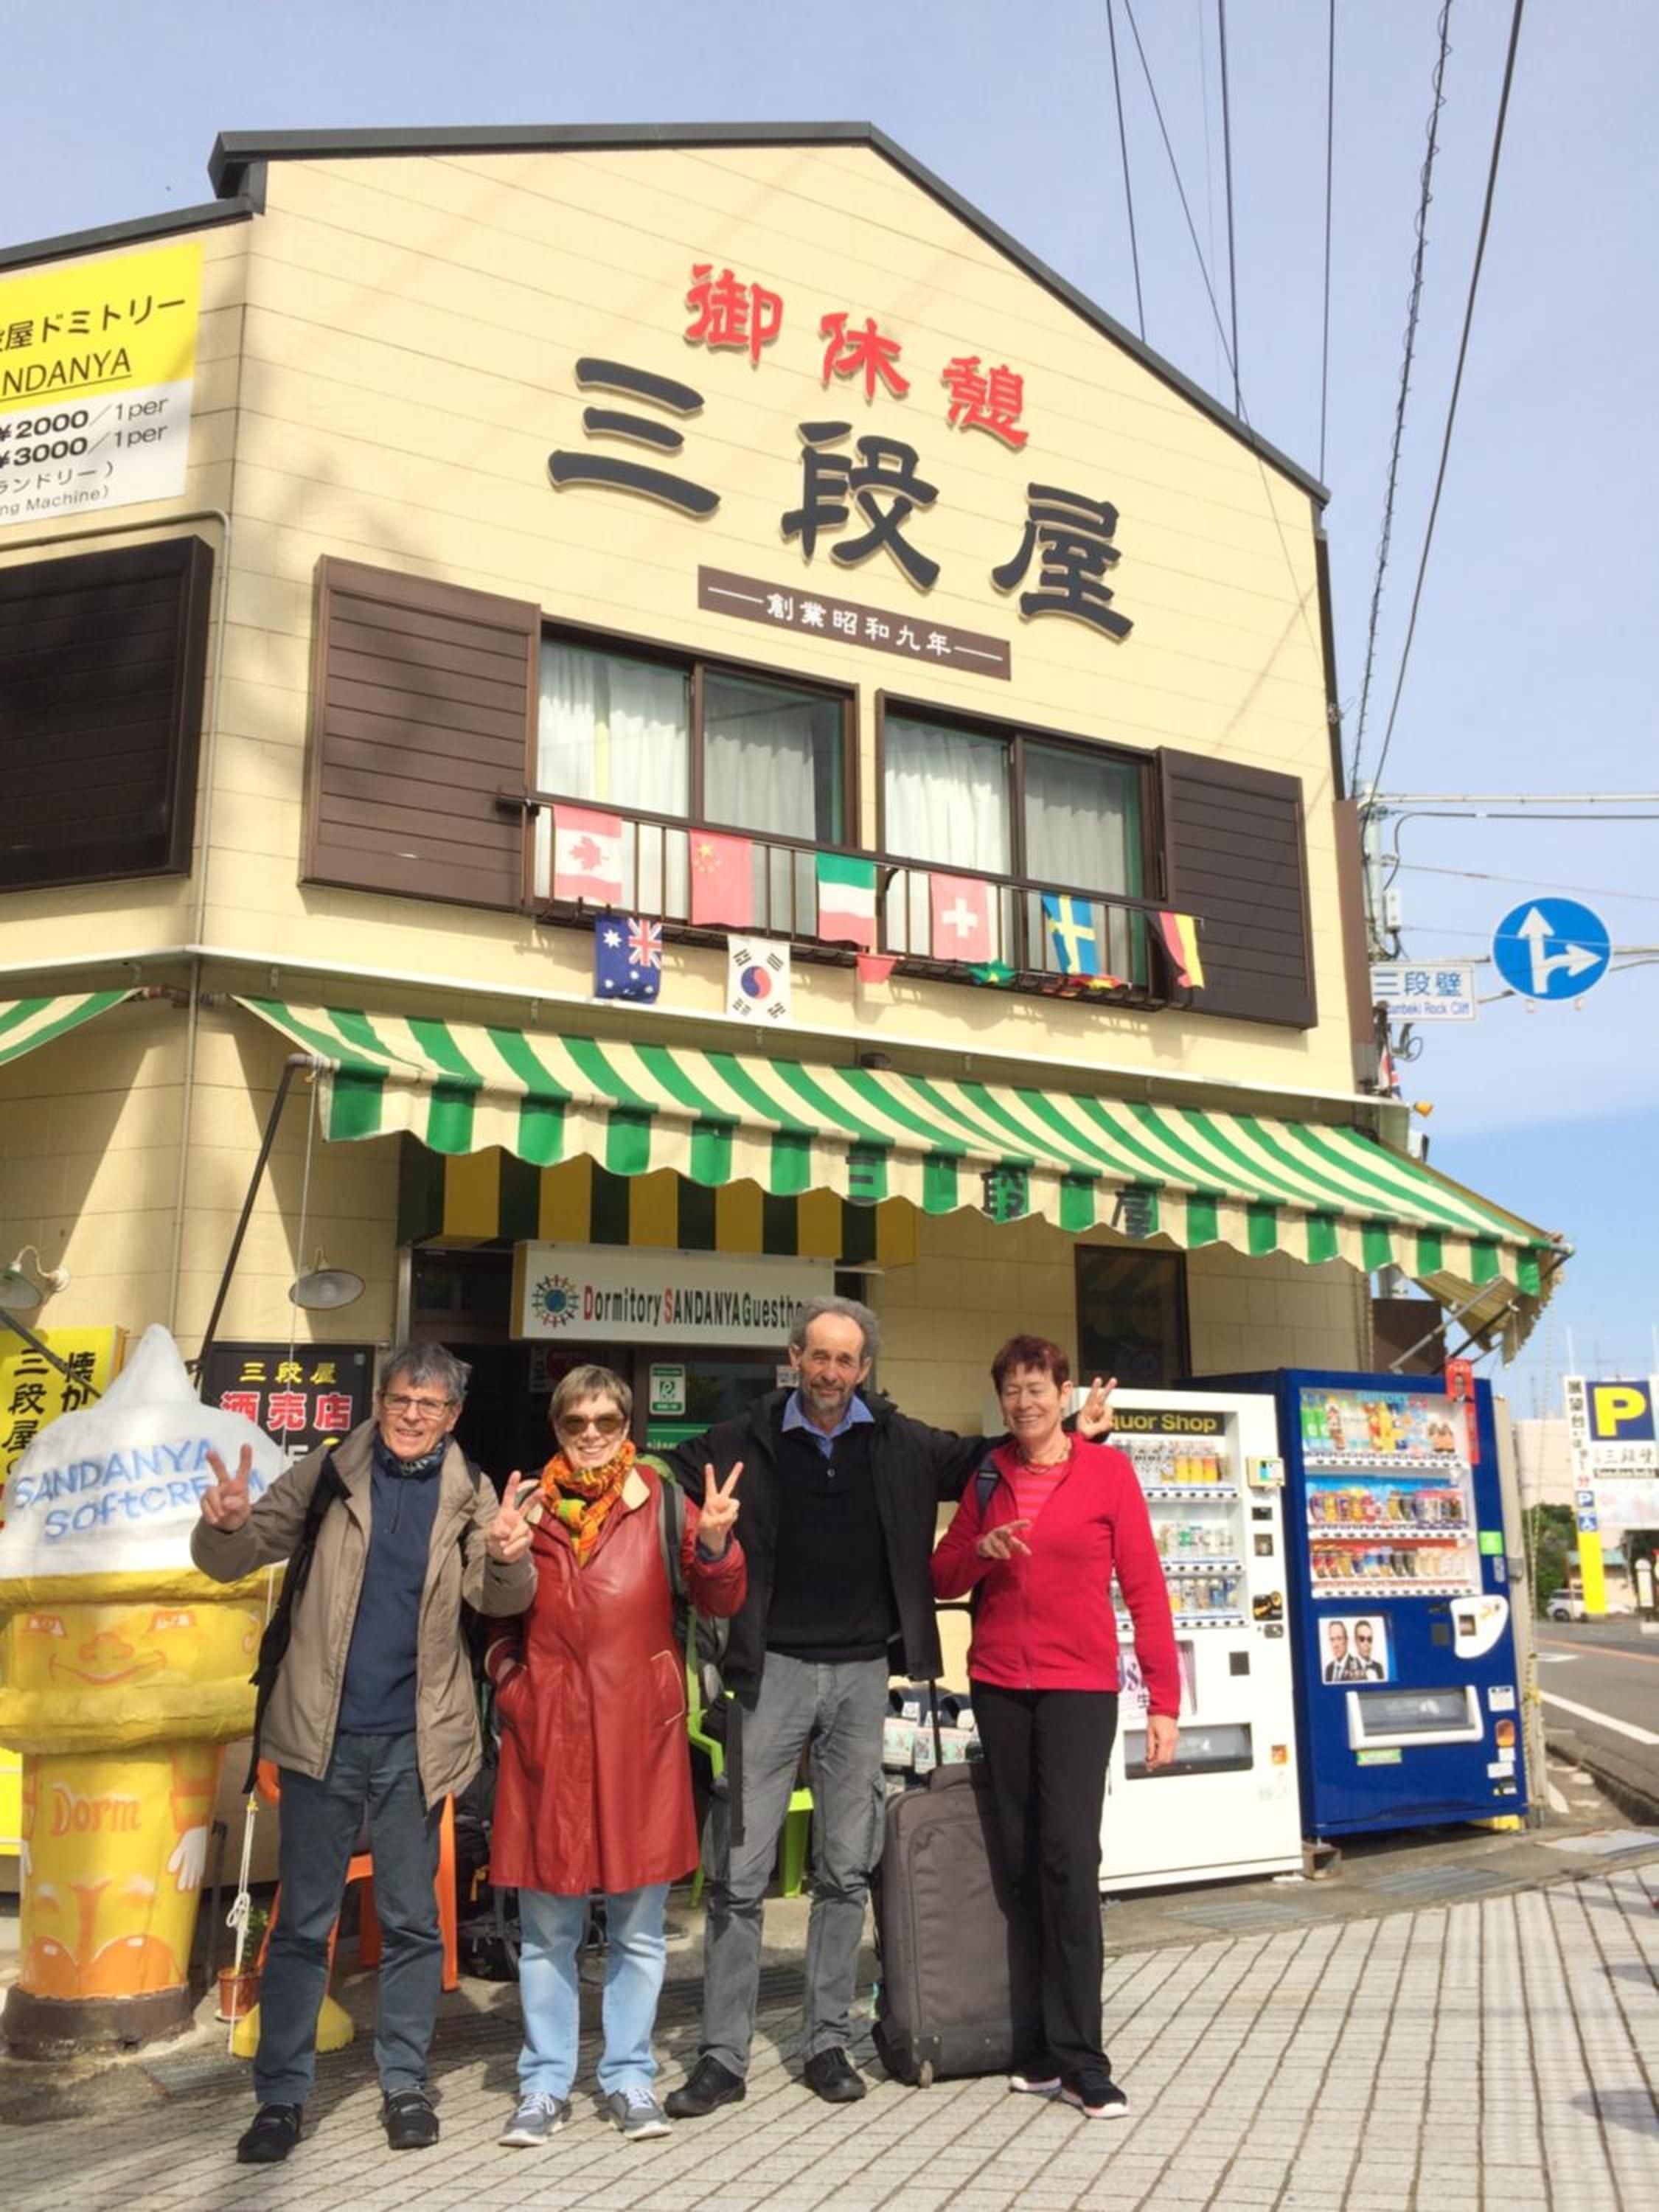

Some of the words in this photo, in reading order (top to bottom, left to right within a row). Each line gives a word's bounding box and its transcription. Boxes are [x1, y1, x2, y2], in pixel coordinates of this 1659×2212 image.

[0, 296, 186, 352] 屋ドミトリー
[686, 264, 1029, 449] 御休憩
[548, 357, 1134, 640] 三段屋
[768, 594, 951, 656] 創業昭和九年
[1373, 970, 1461, 997] 三段壁
[583, 1285, 663, 1326] Dormitory
[664, 1287, 740, 1326] SANDANYA
[240, 1362, 337, 1384] 三段屋
[1161, 1413, 1217, 1433] Shop
[1593, 1386, 1646, 1437] P
[51, 1783, 142, 1837] Dorm
